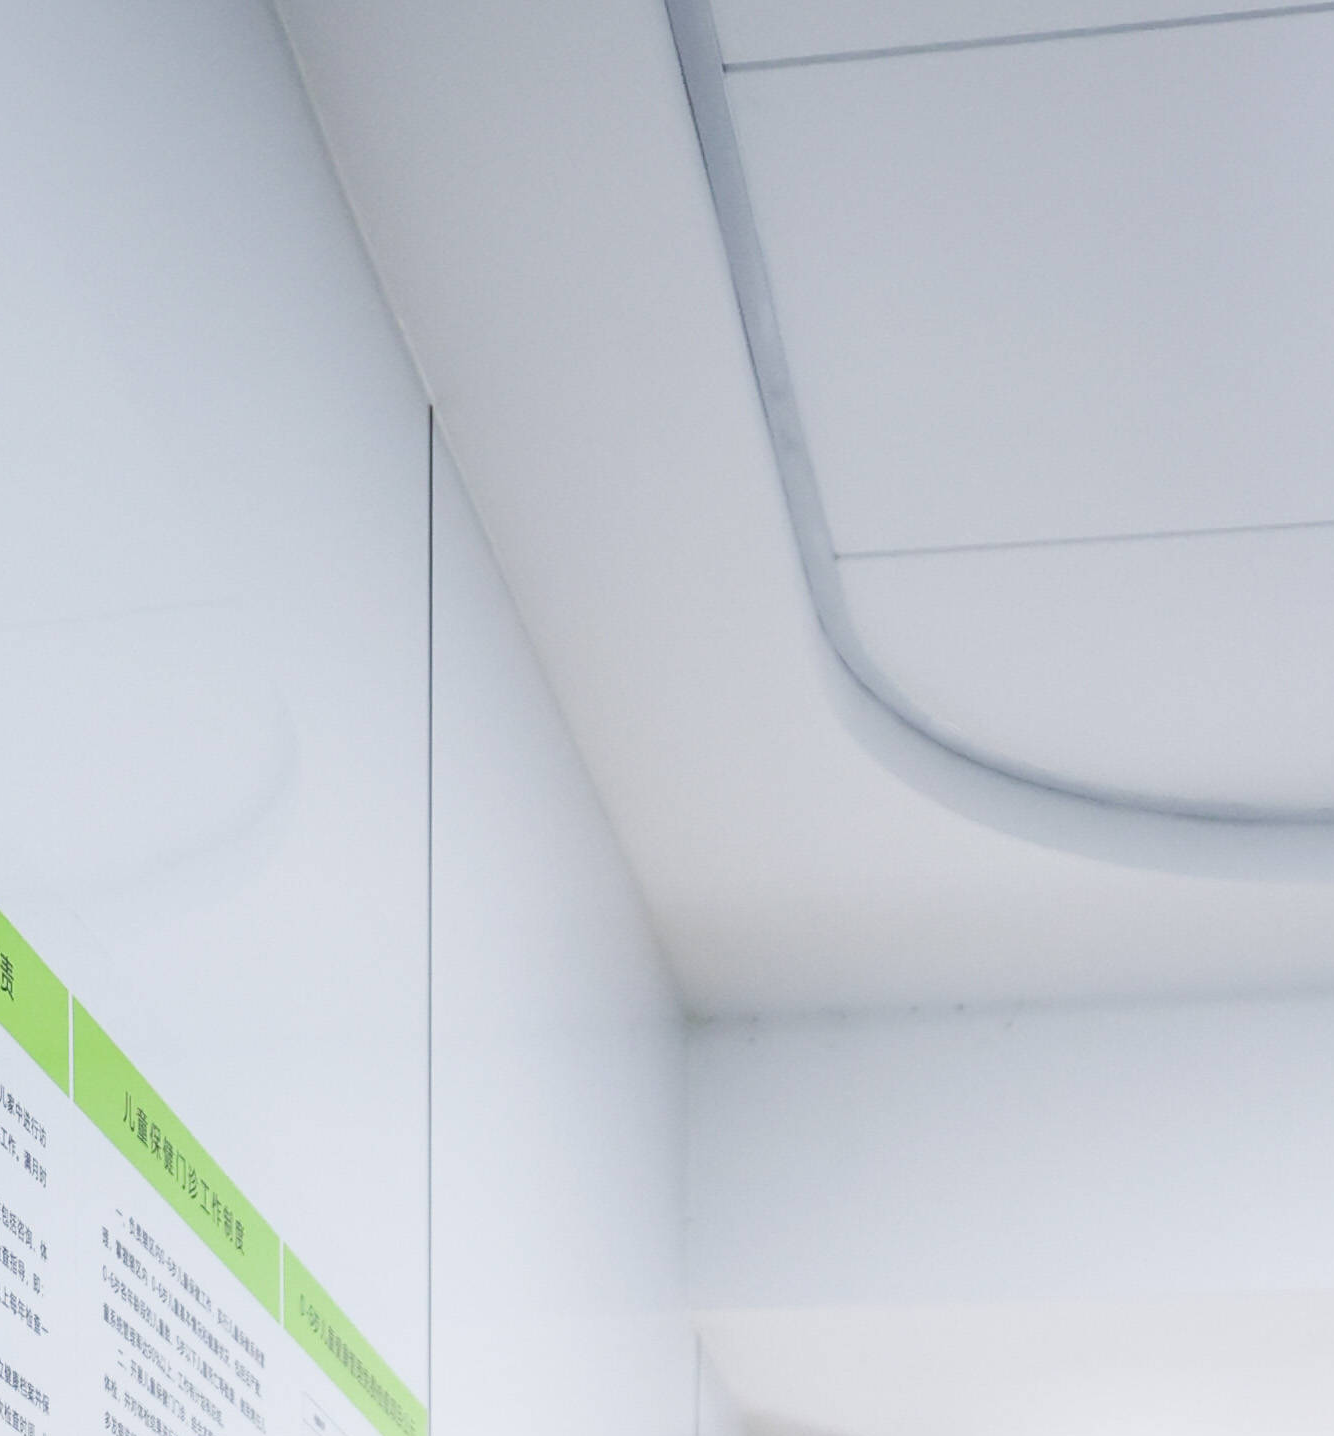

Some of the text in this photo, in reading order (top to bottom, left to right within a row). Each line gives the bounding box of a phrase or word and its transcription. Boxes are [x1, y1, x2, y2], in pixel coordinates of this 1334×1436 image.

[123, 1089, 244, 1258] 儿童保健门诊工作制度
